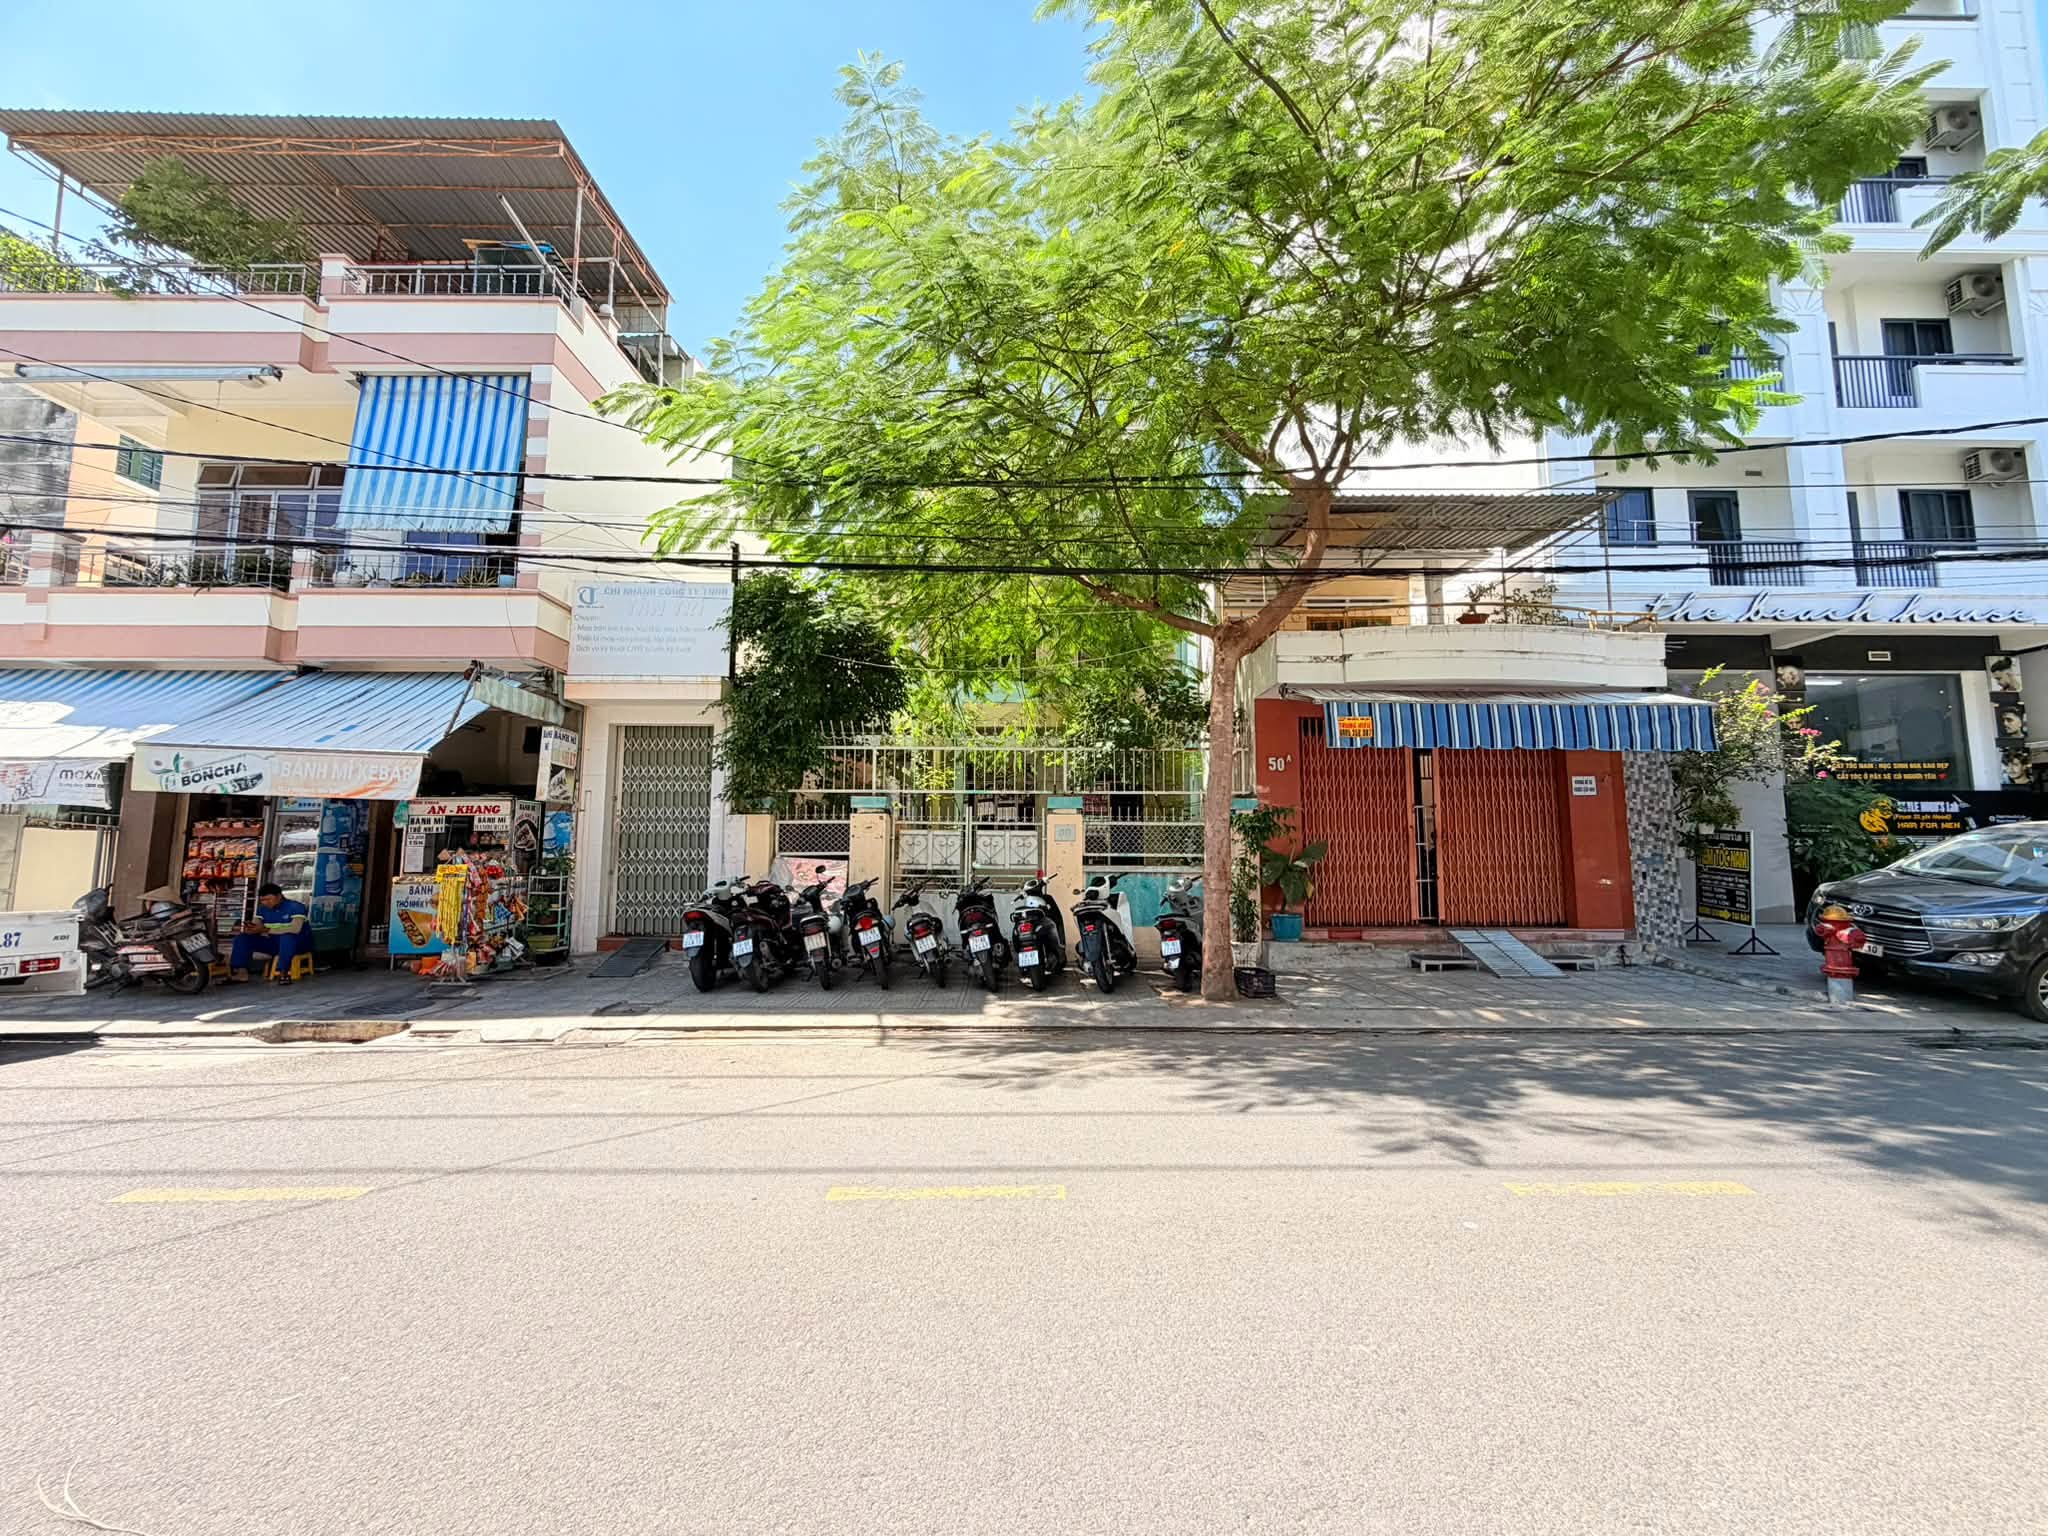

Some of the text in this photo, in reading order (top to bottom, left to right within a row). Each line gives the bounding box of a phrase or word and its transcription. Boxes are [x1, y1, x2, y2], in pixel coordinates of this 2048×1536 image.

[1646, 592, 2036, 623] the beach house
[181, 761, 248, 787] BONCHA
[427, 805, 447, 815] AN
[456, 804, 501, 815] KHANG
